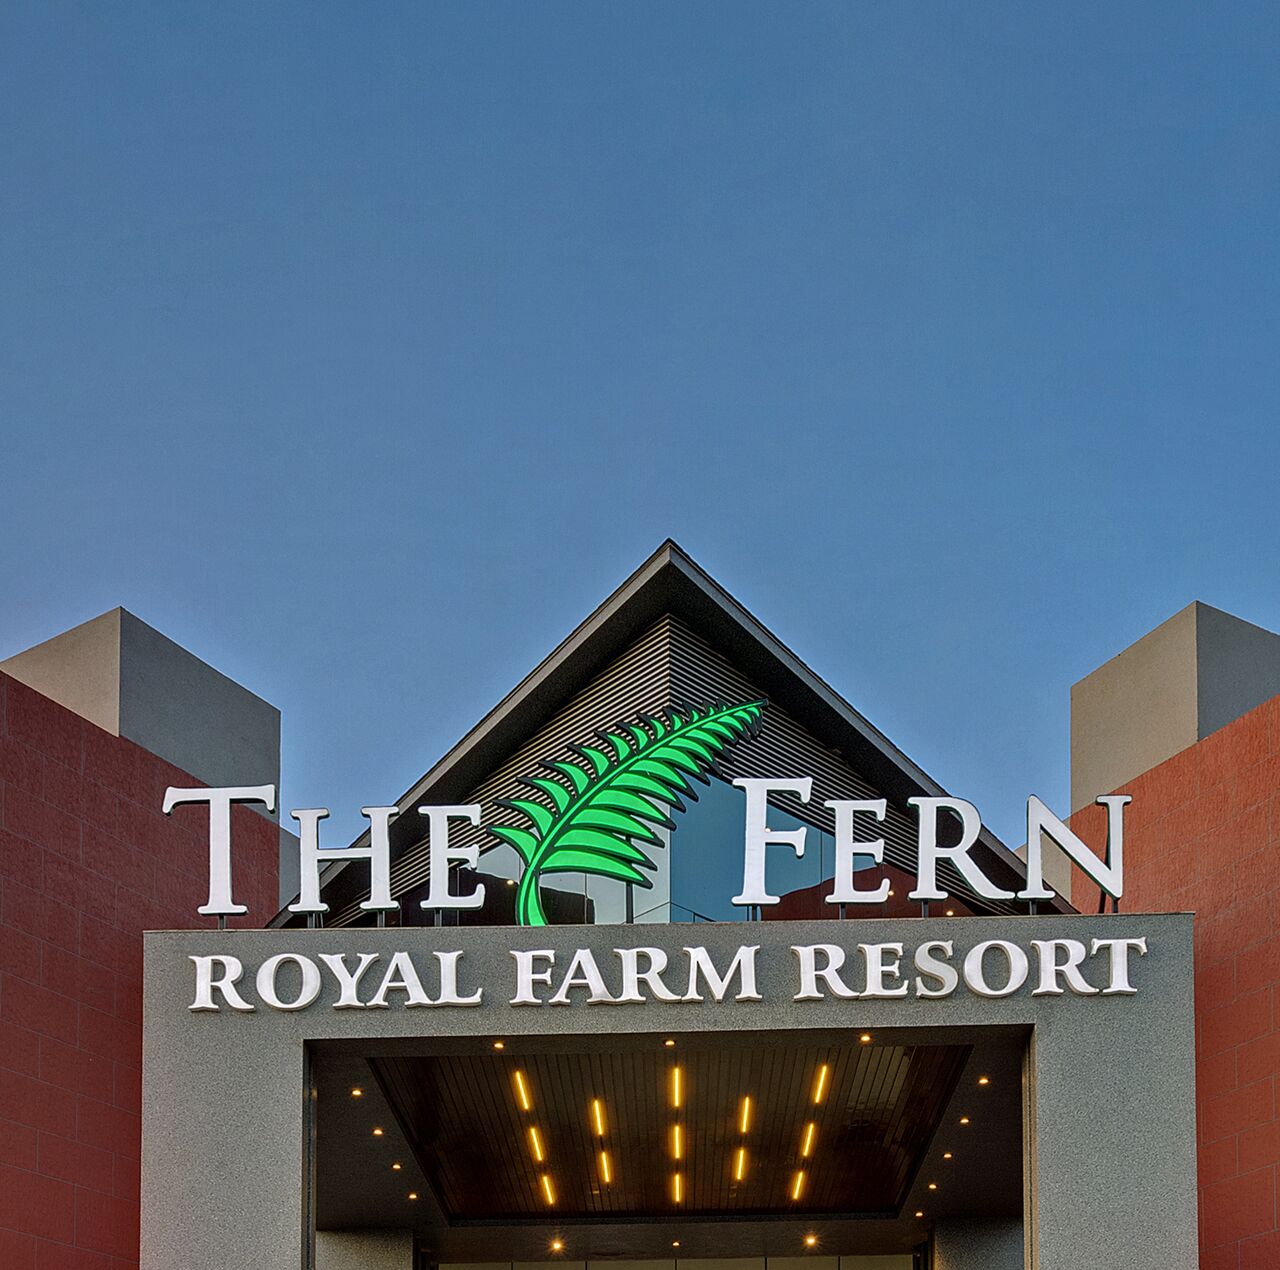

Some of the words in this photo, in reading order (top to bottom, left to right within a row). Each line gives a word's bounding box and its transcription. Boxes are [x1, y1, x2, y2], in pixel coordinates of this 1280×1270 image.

[162, 784, 486, 915] THE
[731, 776, 1132, 907] FERN
[188, 950, 483, 1012] ROYAL
[510, 945, 763, 1005] FARM
[790, 936, 1148, 1000] RESORT
